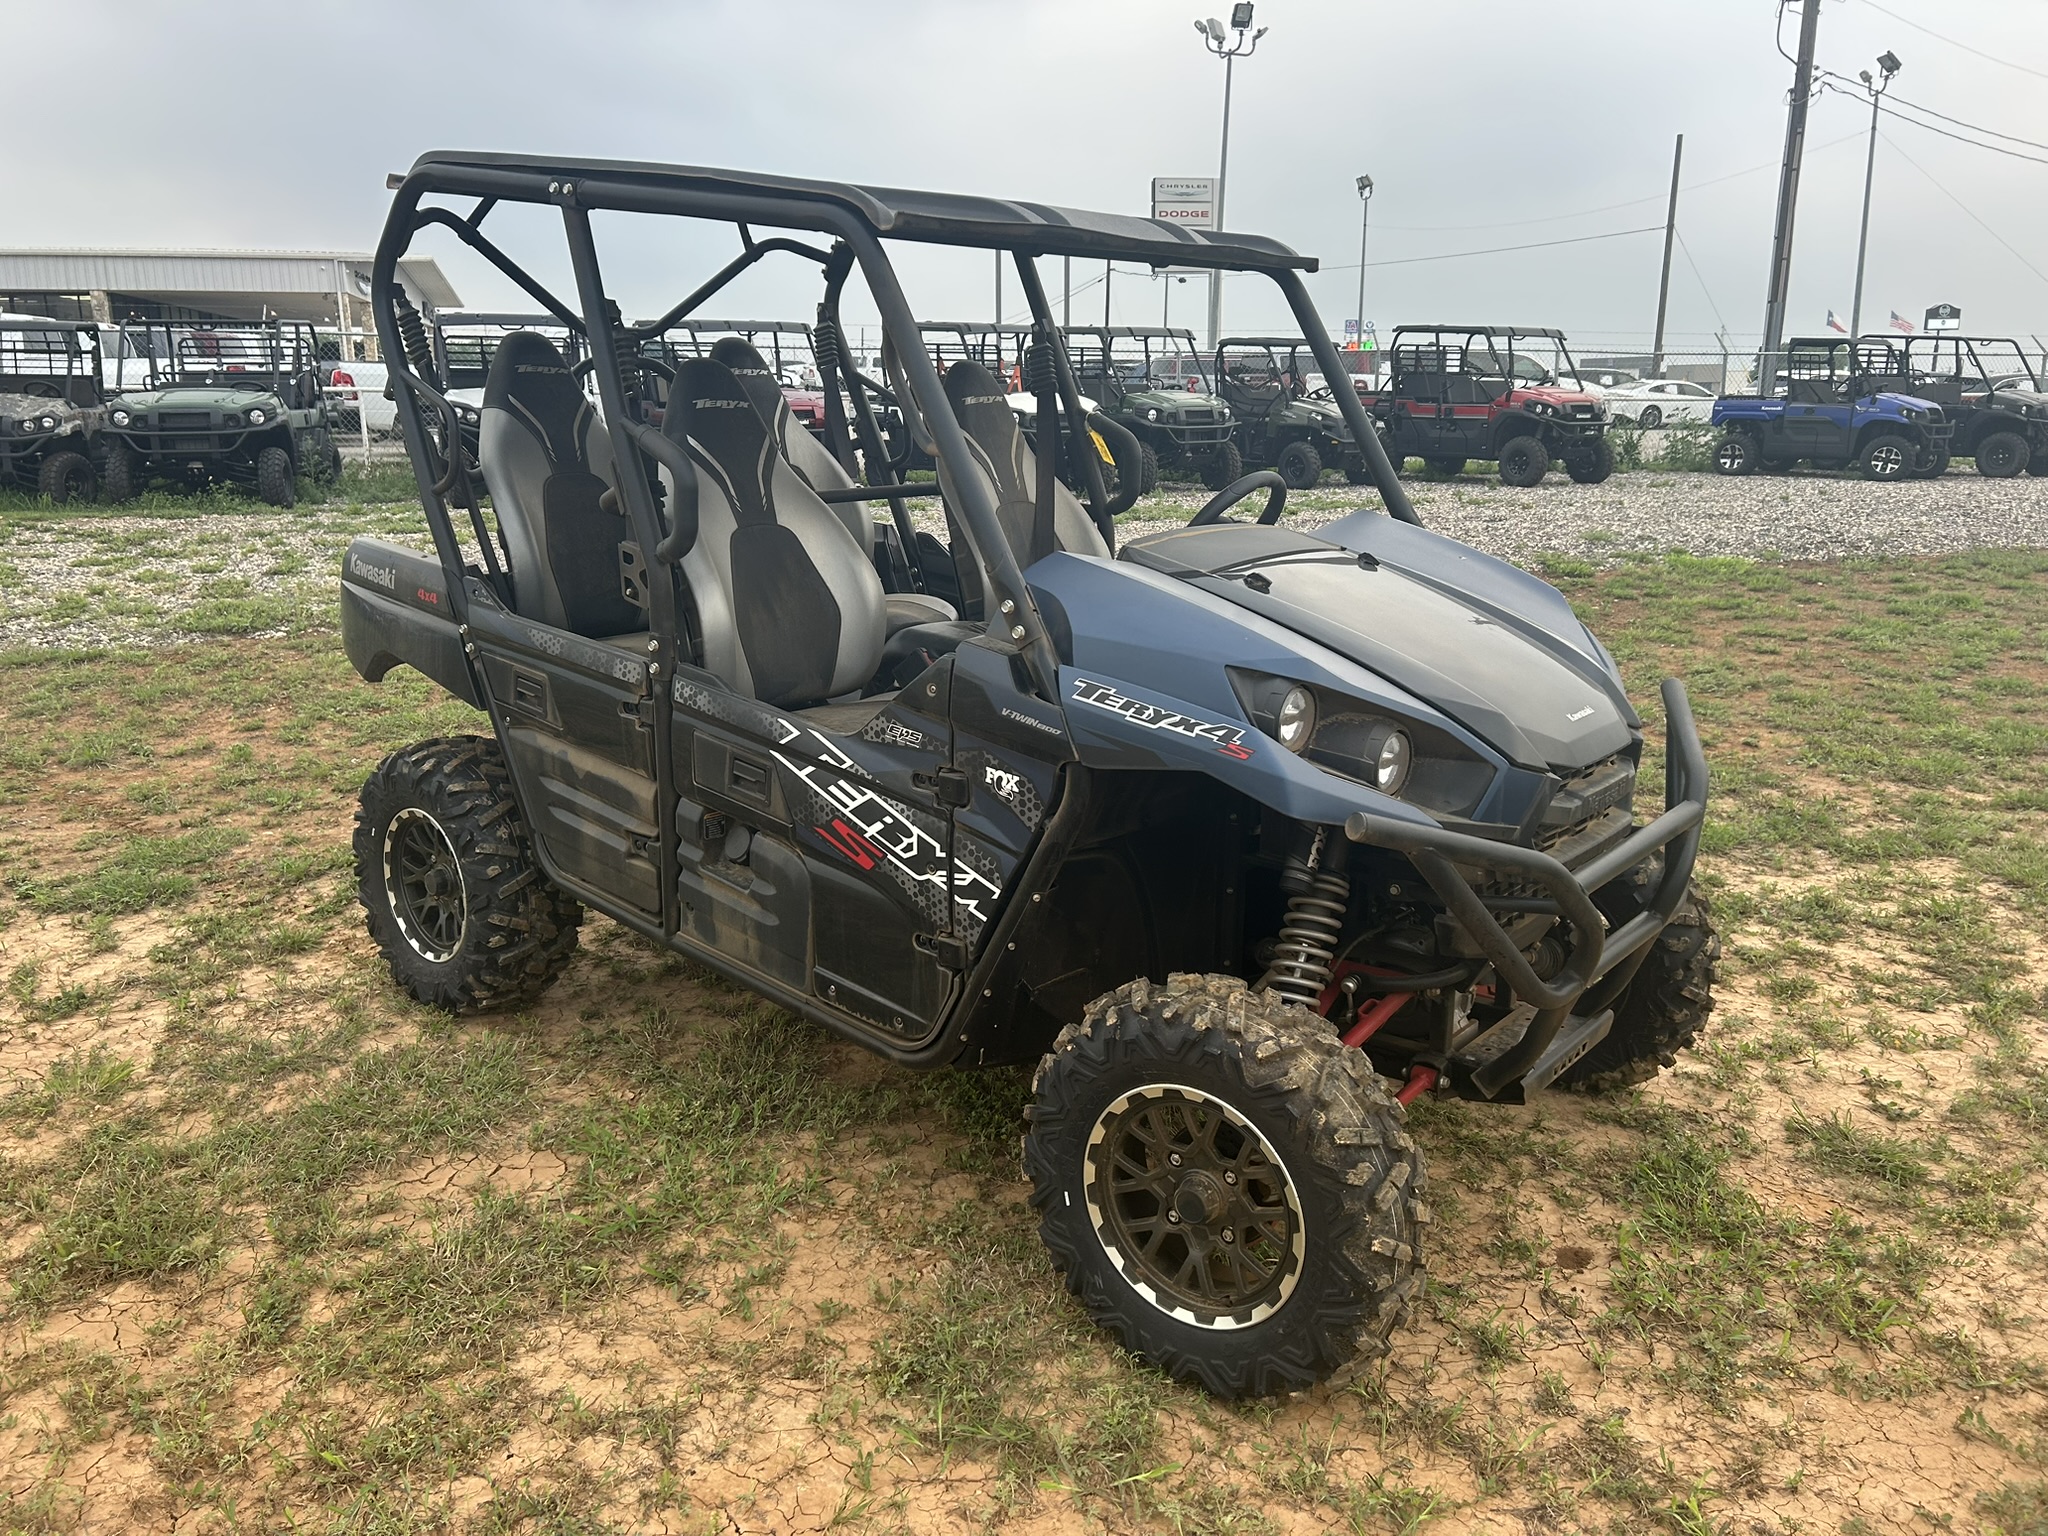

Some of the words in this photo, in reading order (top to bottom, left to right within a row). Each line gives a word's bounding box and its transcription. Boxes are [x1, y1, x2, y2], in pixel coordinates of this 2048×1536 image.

[1158, 210, 1210, 218] DODGE
[692, 398, 750, 409] TERYX
[350, 553, 396, 590] Kawasaki
[417, 587, 438, 605] 4x4
[887, 723, 923, 743] EPS
[1072, 677, 1247, 746] TERYX4
[1216, 743, 1255, 761] S
[984, 766, 1020, 800] FOX
[814, 818, 886, 871] S
